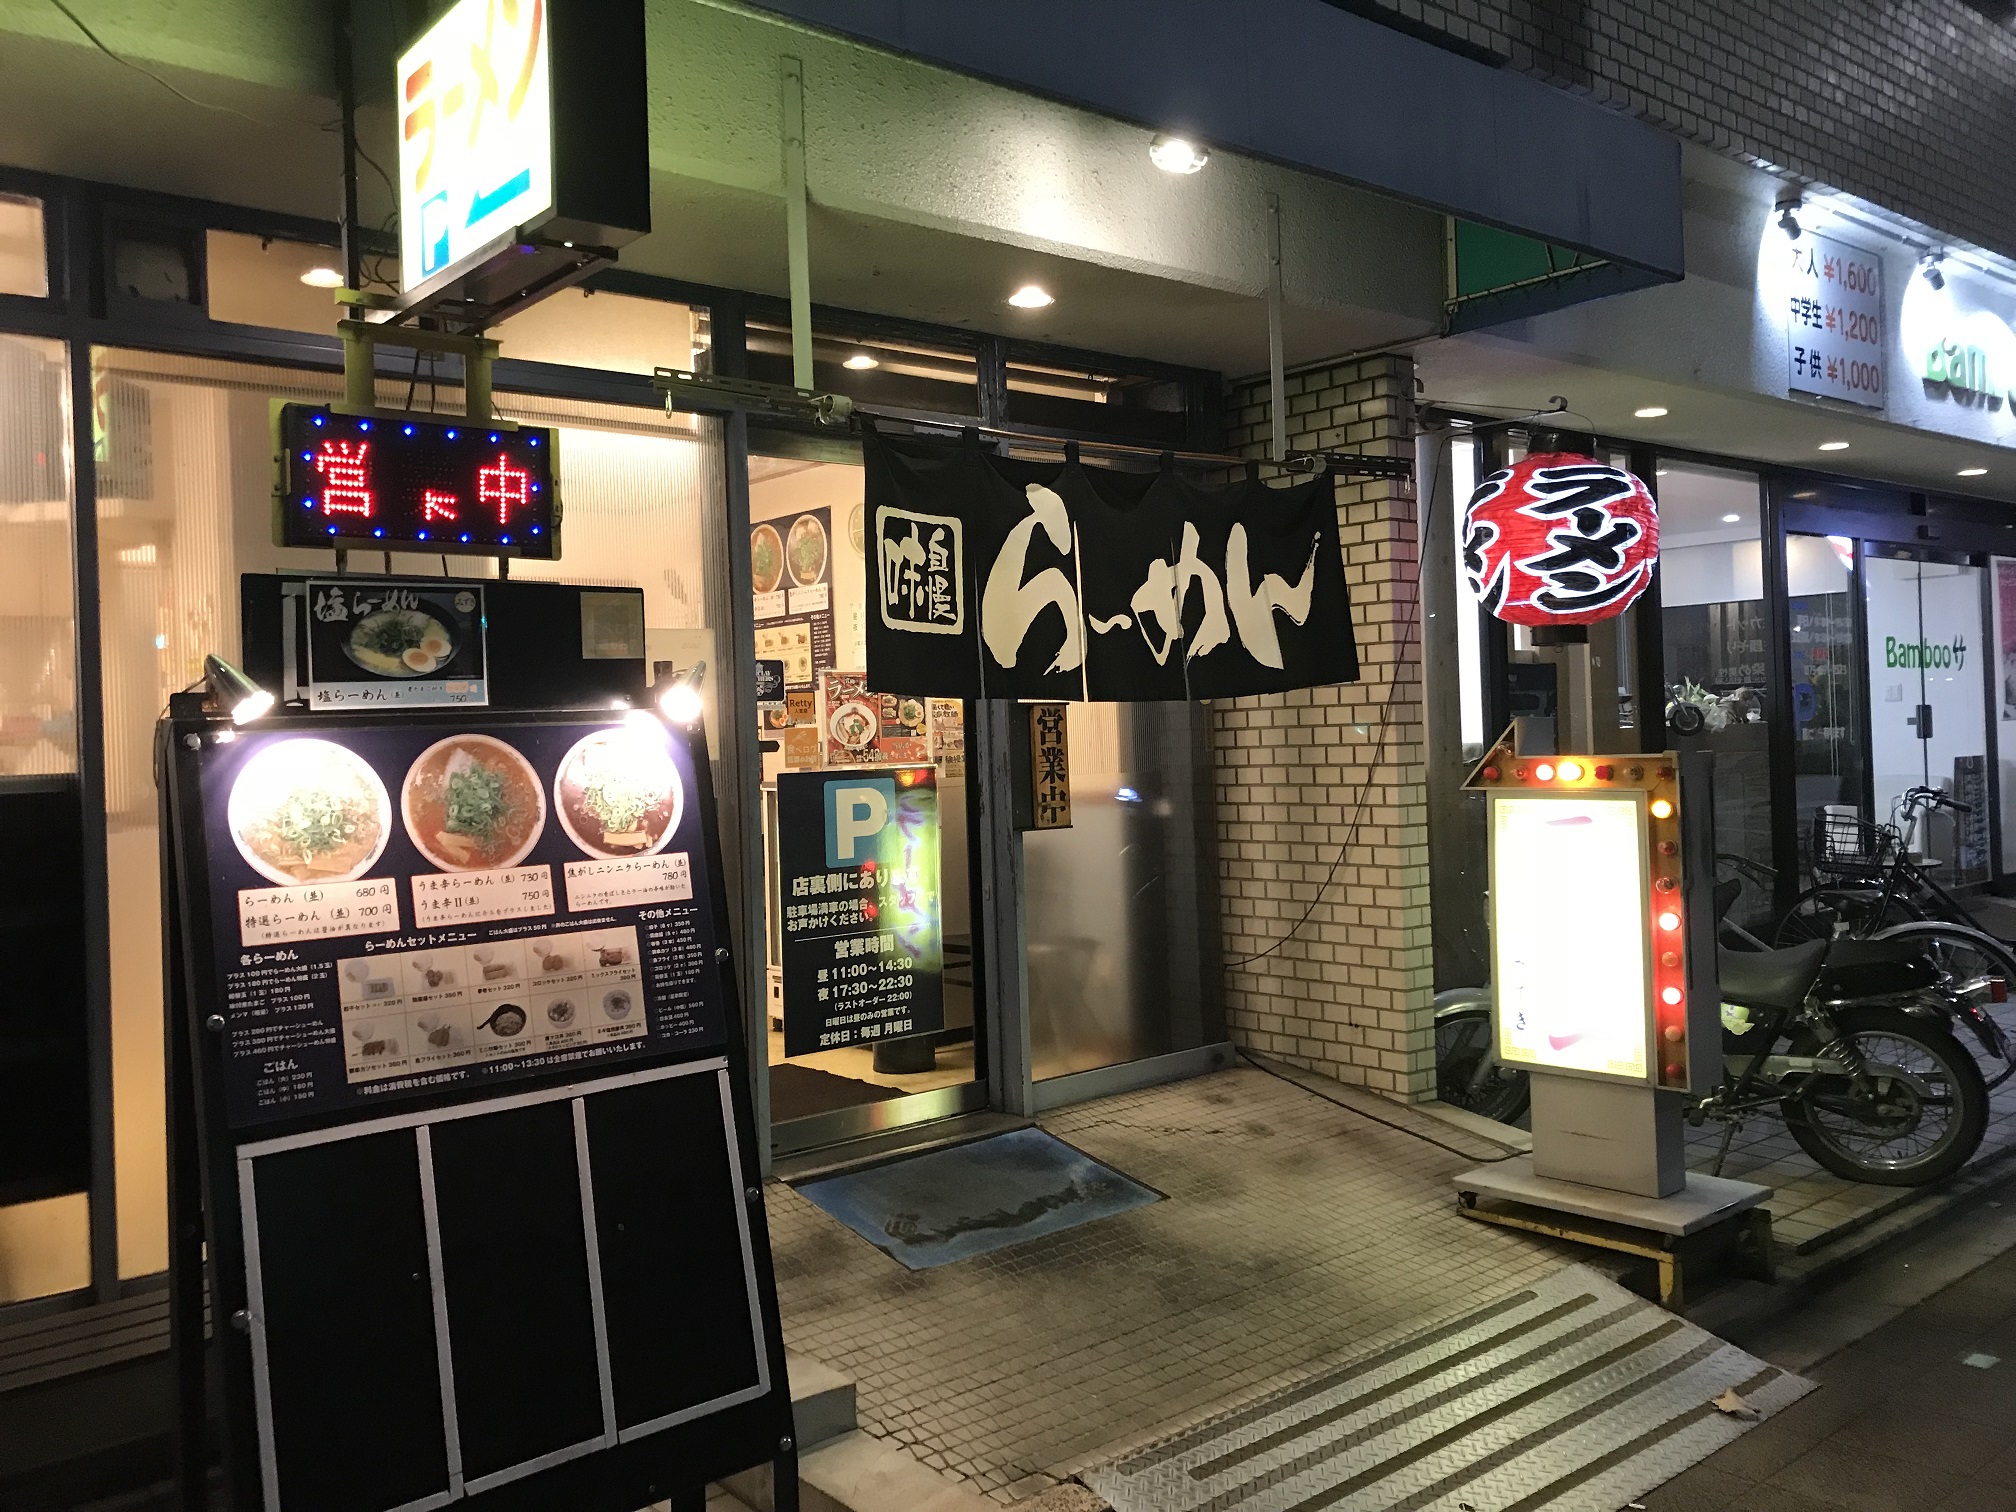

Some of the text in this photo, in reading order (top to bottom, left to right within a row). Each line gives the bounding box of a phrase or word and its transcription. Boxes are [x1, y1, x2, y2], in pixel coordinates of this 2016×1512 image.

[1792, 247, 1877, 297] 大人 ¥1,600
[1790, 296, 1878, 345] 中学生 ¥1,200
[1794, 346, 1880, 393] 子供 ¥1,000
[982, 483, 1321, 676] らーめん
[314, 586, 419, 622] 塩らーめん
[1885, 636, 1951, 669] Bamboo
[317, 689, 388, 703] 塩らーめん
[789, 699, 813, 708] Retty
[1037, 707, 1067, 824] 営業中
[836, 787, 888, 860] P
[520, 871, 549, 882] 730円
[662, 870, 688, 881] 780円
[356, 885, 390, 897] 680円
[522, 889, 550, 900] 750円
[358, 903, 392, 917] 700円
[638, 907, 698, 920] その他メニュー
[786, 912, 874, 933] お声かけください。
[365, 932, 477, 952] らーめんセットメニュー
[834, 933, 894, 960] 営業時間
[240, 949, 299, 966] 各らーめん
[817, 956, 913, 983] 昼 11:00〜14:30
[817, 974, 913, 1001] 夜 17:30〜22:30
[884, 1018, 913, 1035] 月曜日
[263, 1058, 299, 1074] ごはん
